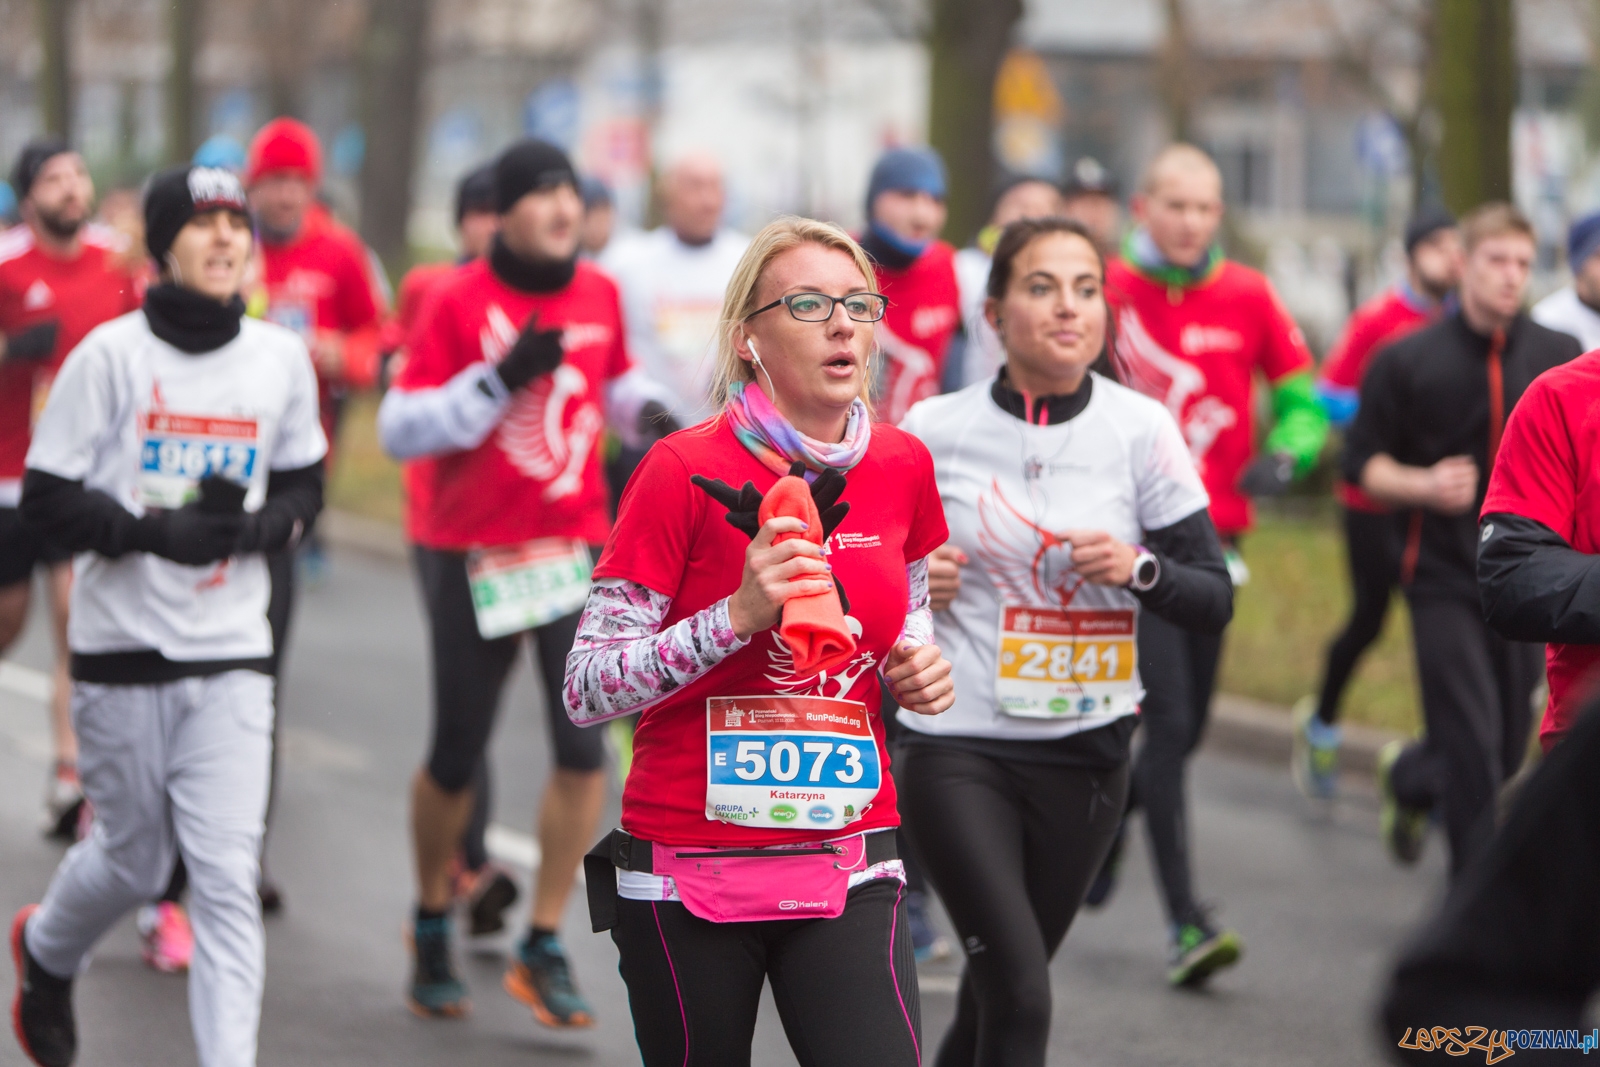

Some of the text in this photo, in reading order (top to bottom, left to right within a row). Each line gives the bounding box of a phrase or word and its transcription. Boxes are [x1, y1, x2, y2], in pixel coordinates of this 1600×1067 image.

[835, 533, 846, 549] 1
[1018, 643, 1119, 680] 2841
[748, 709, 861, 729] 1 RunPoland.org
[714, 740, 864, 784] E 5073
[769, 790, 826, 802] Katarzyna
[715, 804, 744, 813] GRUPA
[798, 900, 829, 909] Kalenji
